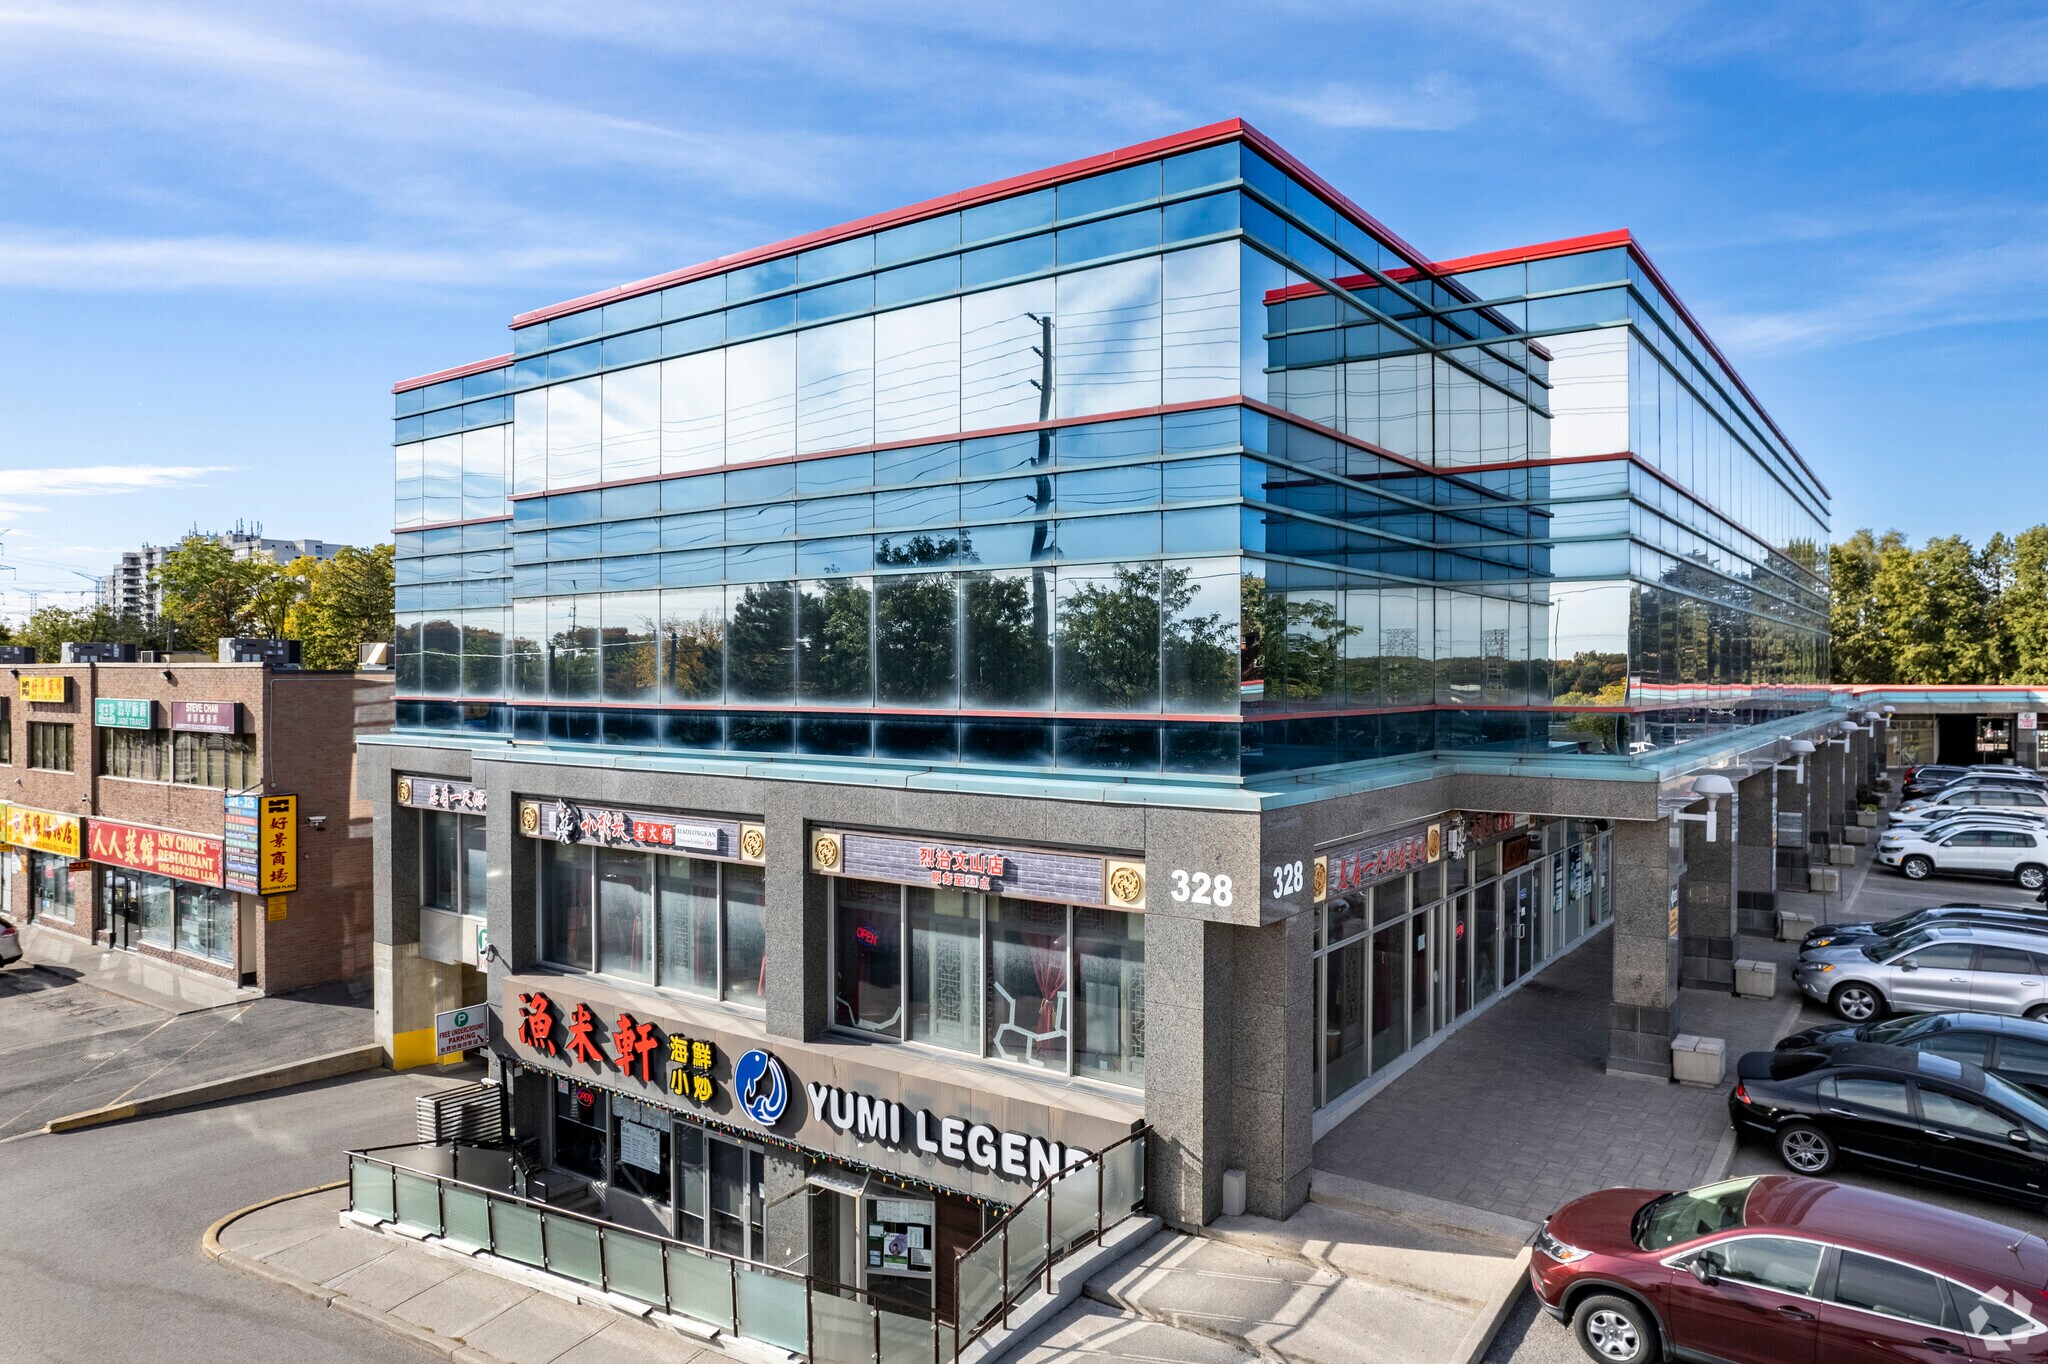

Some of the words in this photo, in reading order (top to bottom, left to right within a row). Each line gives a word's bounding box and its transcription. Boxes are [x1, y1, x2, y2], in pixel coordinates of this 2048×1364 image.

[185, 703, 203, 712] STEVE
[204, 703, 219, 713] CHAN
[117, 717, 129, 725] JADE
[129, 718, 147, 727] TRAVEL
[158, 832, 174, 849] NEW
[176, 835, 207, 855] CHOICE
[677, 828, 716, 838] XIAOLONGKAN
[93, 827, 155, 867] 人人菜館
[270, 816, 288, 883] 好景商場
[157, 849, 214, 871] RESTAURANT
[919, 847, 1004, 876] 烈治文山店
[931, 871, 991, 891] 服务至23点
[1170, 869, 1233, 907] 328
[1273, 860, 1304, 899] 328
[856, 927, 877, 945] OPEN
[439, 1030, 451, 1039] FREE
[451, 1022, 485, 1036] UNDERGROUND
[448, 1032, 476, 1044] PARKING
[518, 991, 659, 1083] 漁米軒
[669, 1033, 714, 1071] 海鮮
[671, 1067, 714, 1102] 小炒
[577, 1090, 594, 1104] OPEN
[806, 1080, 902, 1144] YUMI
